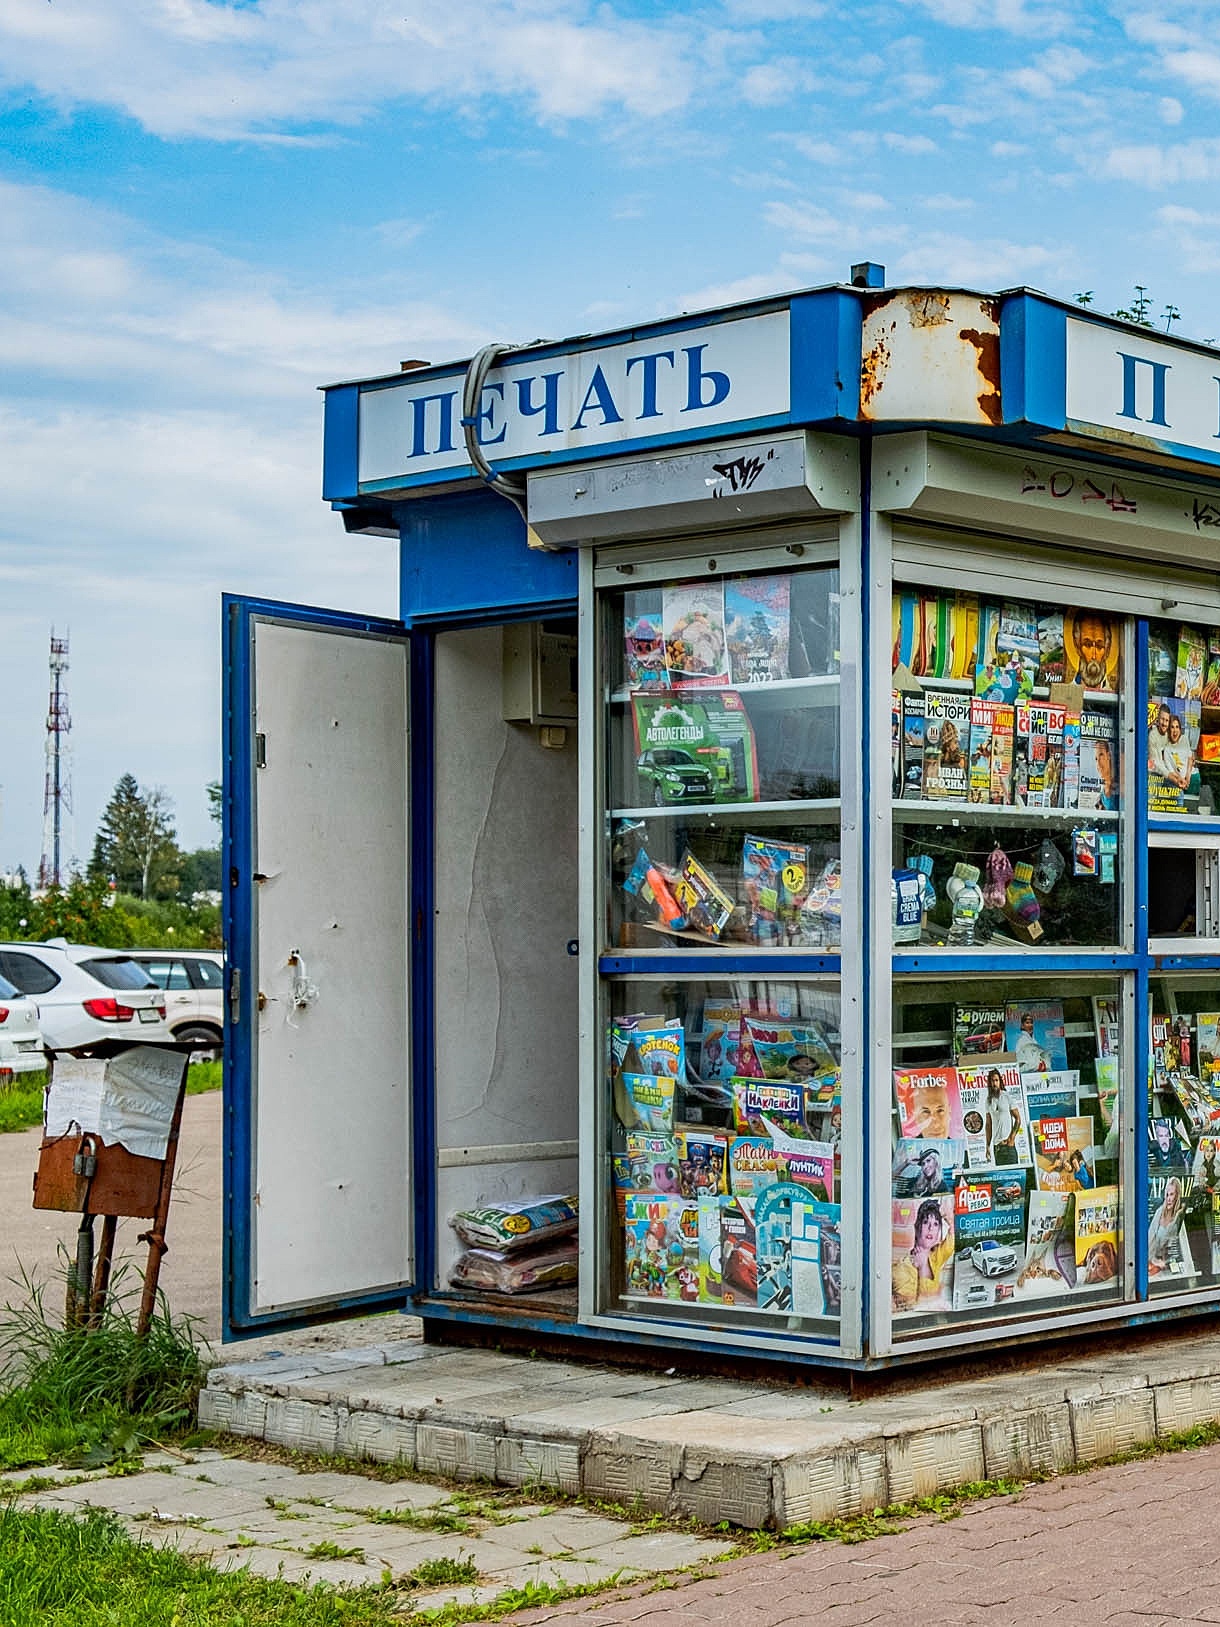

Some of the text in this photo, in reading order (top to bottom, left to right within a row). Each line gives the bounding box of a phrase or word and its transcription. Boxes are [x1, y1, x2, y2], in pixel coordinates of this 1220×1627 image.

[406, 343, 731, 458] ПЕЧАТЬ
[646, 726, 704, 742] АВТОЛЕГЕНДЫ
[900, 902, 920, 912] CREMA
[909, 1074, 948, 1088] Forbes
[748, 1092, 800, 1110] НАКЛЕЙКИ
[1042, 1122, 1064, 1133] ИДЕИ
[1044, 1139, 1066, 1150] ДОМА
[789, 1158, 825, 1177] ЛУНТИК
[970, 1199, 989, 1210] РЕВЮ
[959, 1214, 1020, 1230] Святая троица
